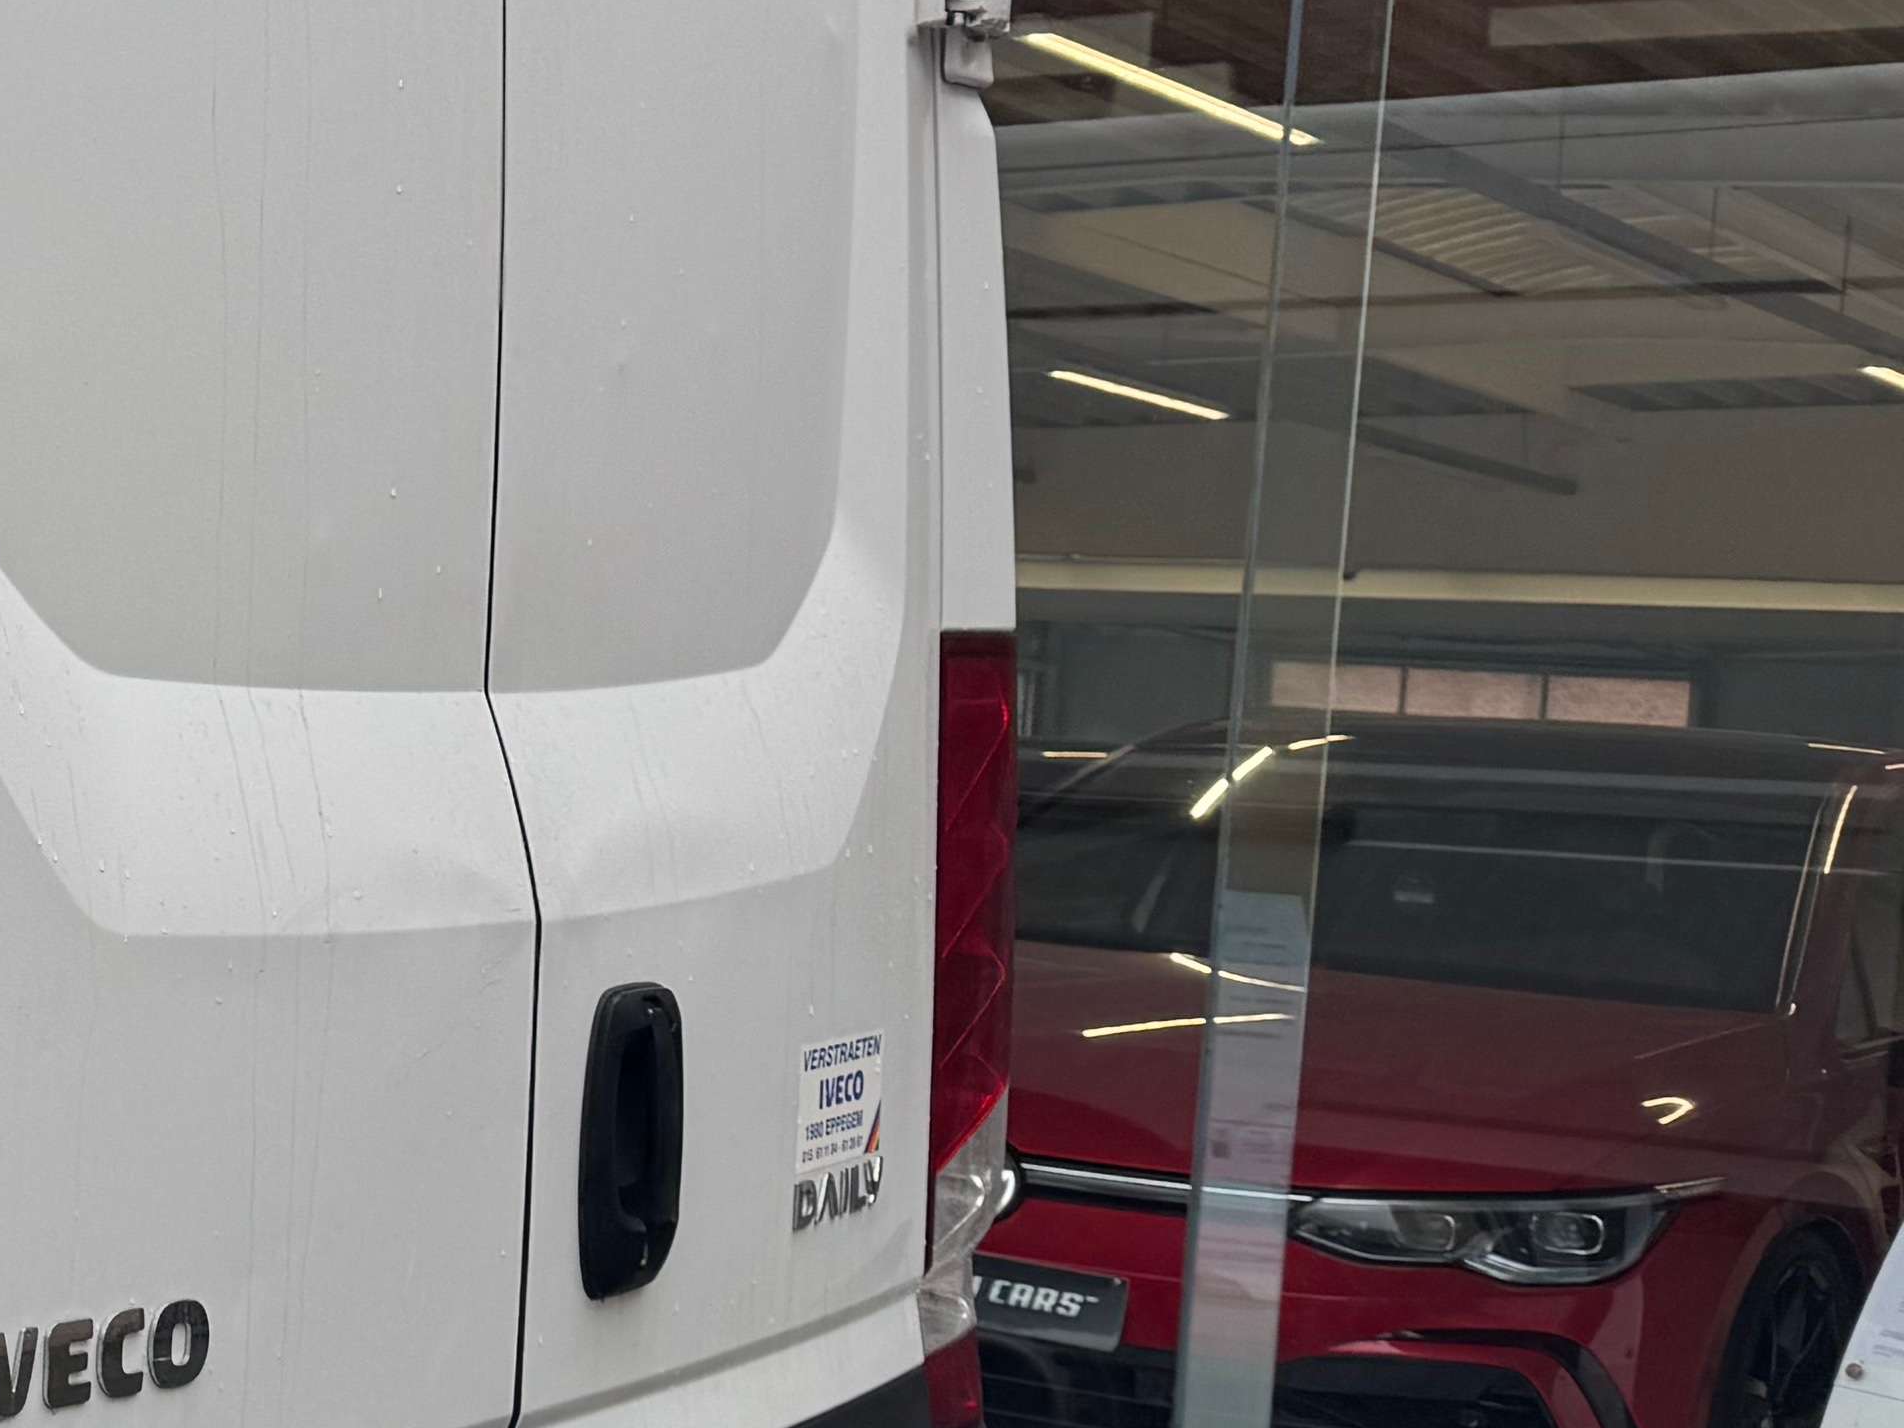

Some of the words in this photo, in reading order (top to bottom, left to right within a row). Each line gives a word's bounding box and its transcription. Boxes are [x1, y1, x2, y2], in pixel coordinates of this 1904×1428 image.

[804, 1034, 882, 1072] VERSTRAETEN
[819, 1070, 864, 1109] IVECO
[792, 1156, 883, 1231] DAILY
[988, 1279, 1085, 1318] CARS
